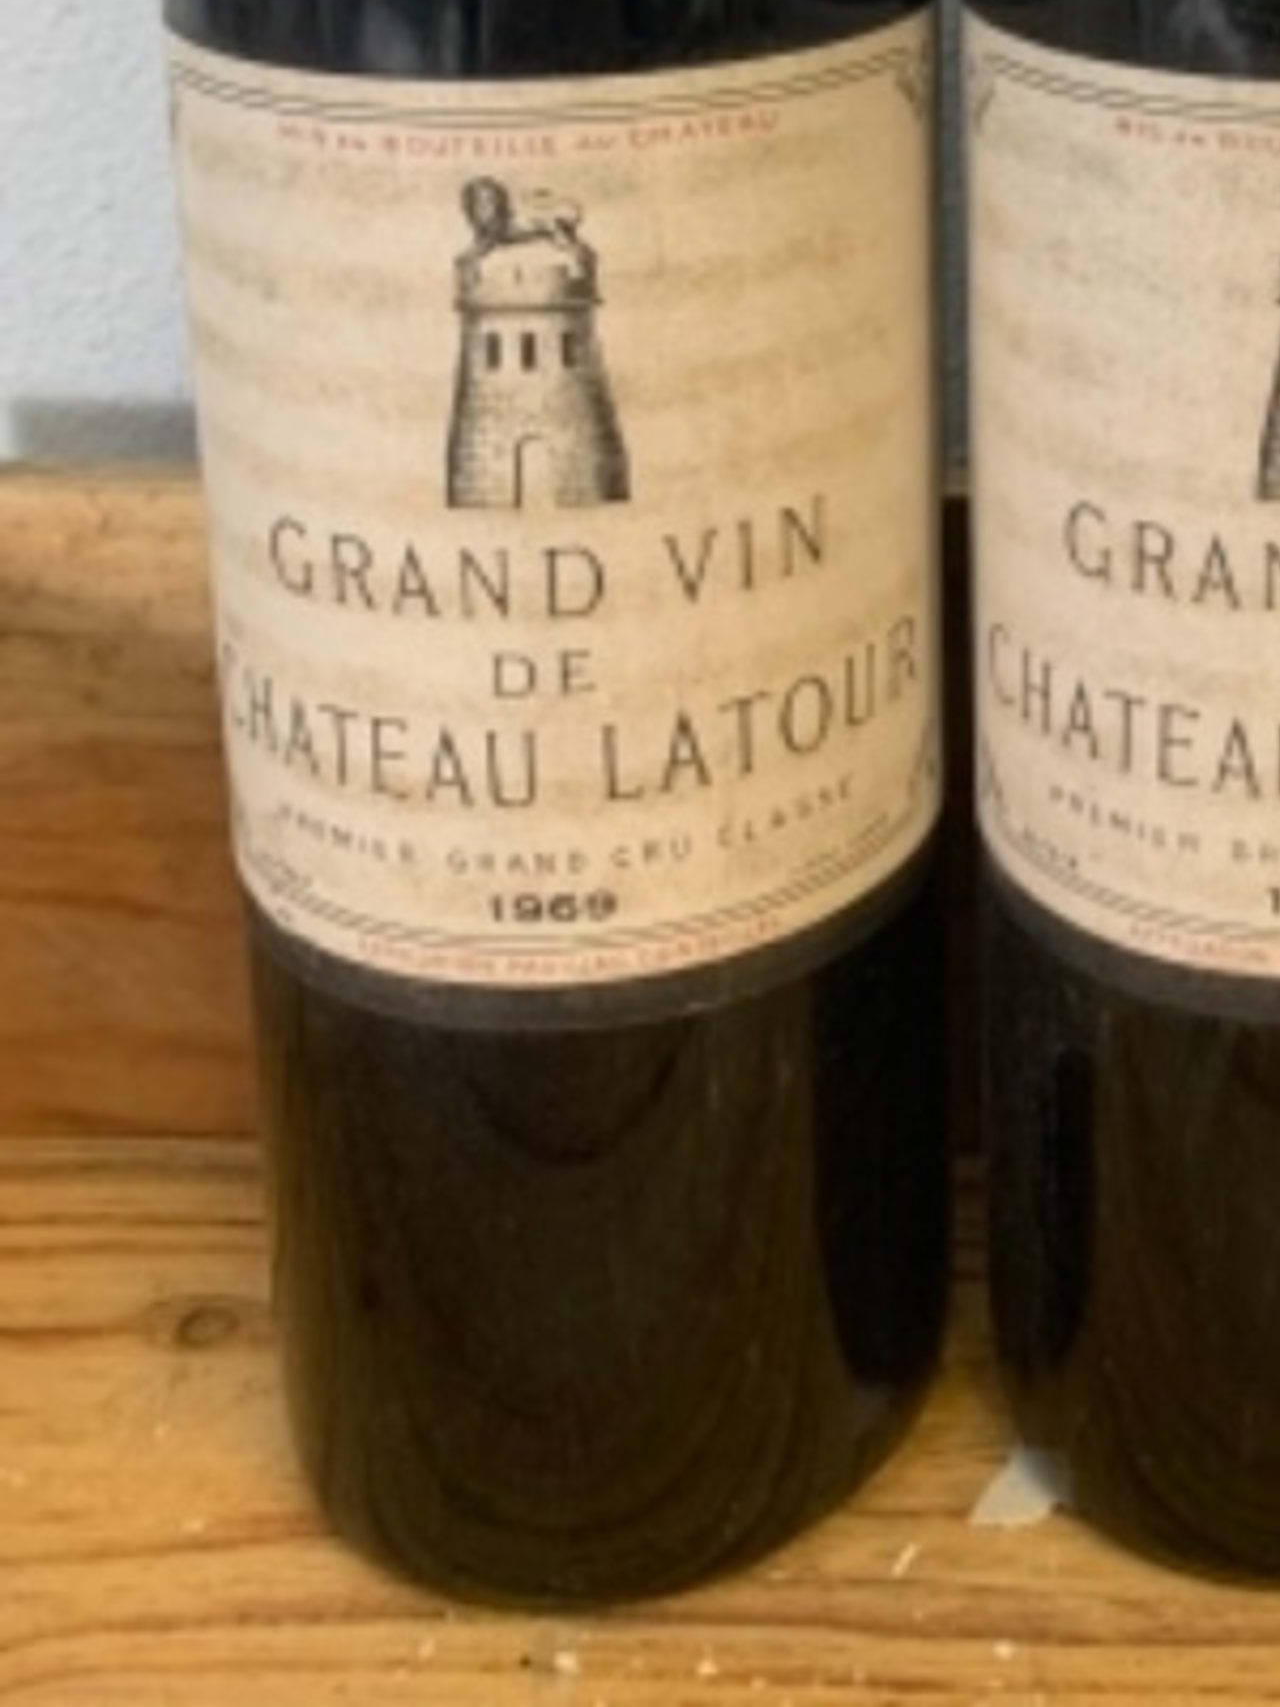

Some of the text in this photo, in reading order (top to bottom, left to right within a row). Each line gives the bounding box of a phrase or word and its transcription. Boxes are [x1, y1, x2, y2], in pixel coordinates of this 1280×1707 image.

[268, 496, 827, 621] GRAND VIN
[493, 648, 597, 700] DE
[602, 615, 920, 804] LATOUR
[446, 847, 590, 877] GRAND
[609, 835, 693, 871] CRU
[489, 891, 618, 924] 1969
